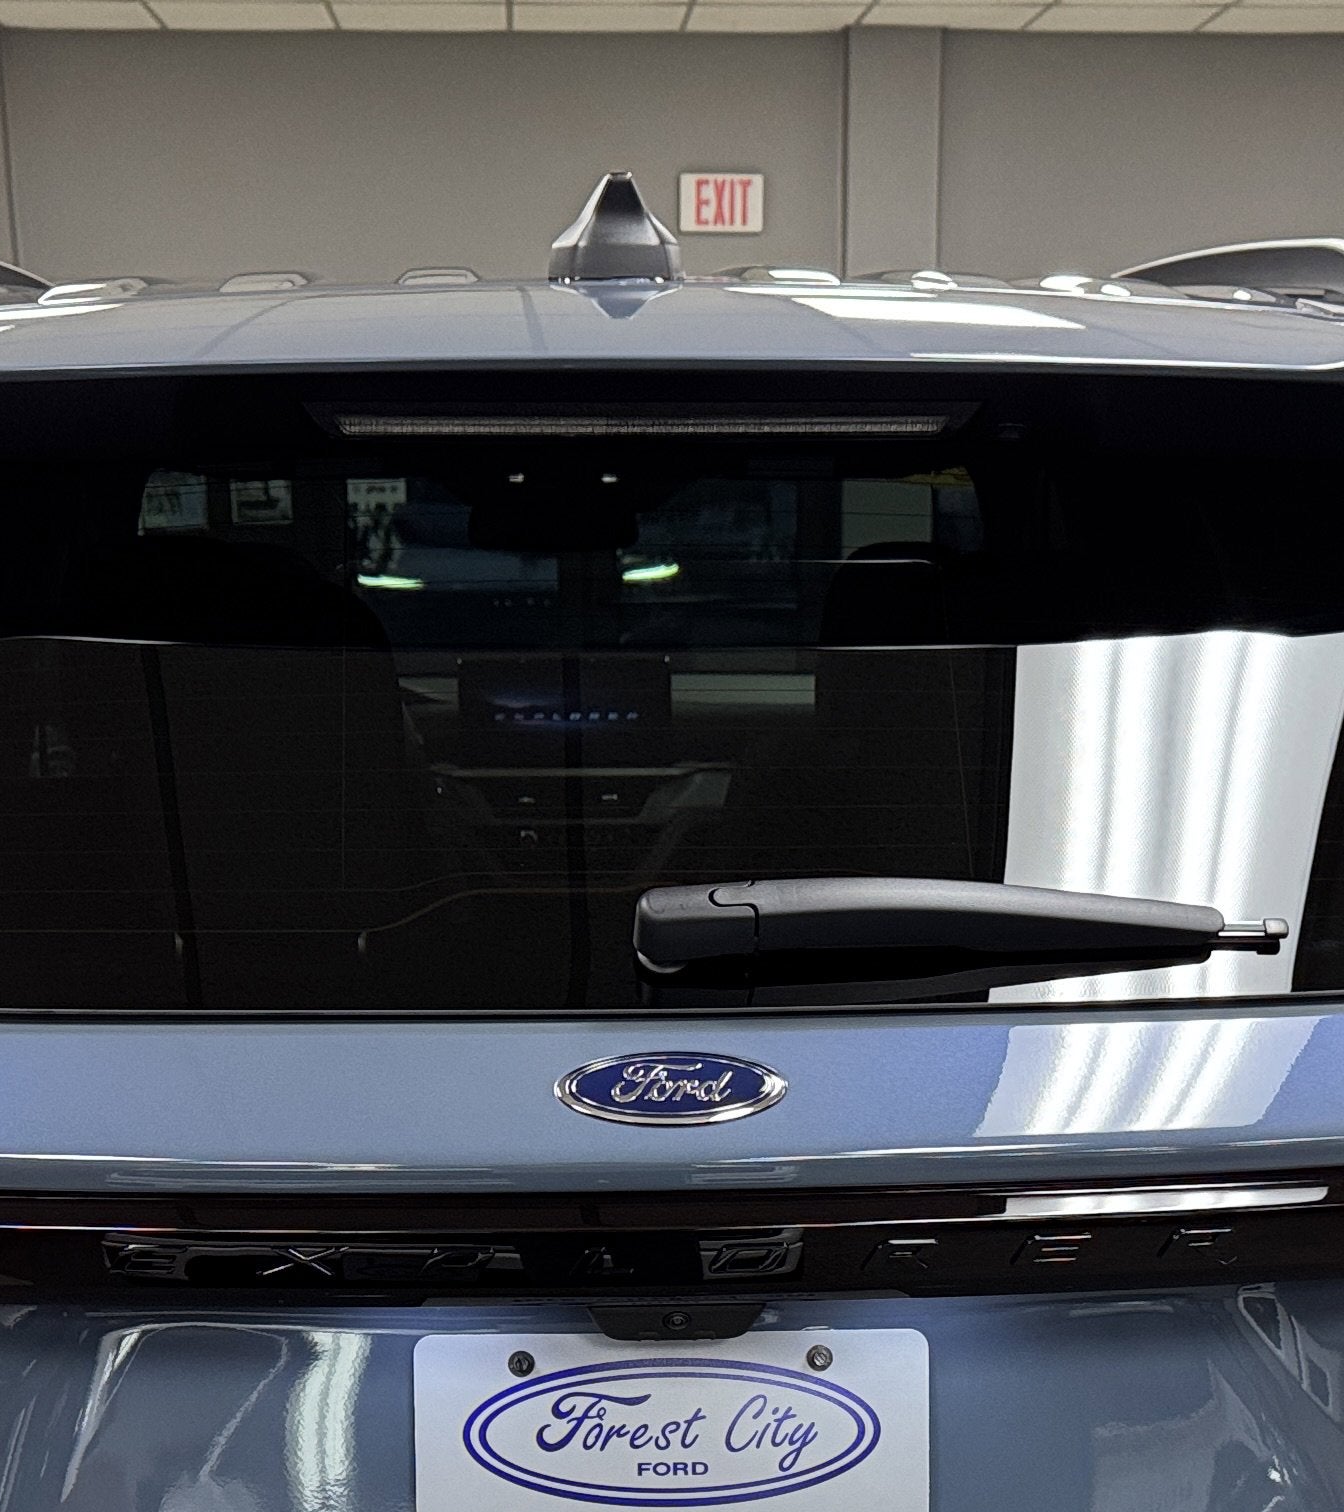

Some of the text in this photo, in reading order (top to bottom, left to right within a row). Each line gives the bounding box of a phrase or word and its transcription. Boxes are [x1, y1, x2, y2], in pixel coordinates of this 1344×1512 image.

[695, 179, 752, 226] EXIT
[610, 1062, 734, 1103] Ford
[106, 1227, 1240, 1278] EXPLORER
[536, 1391, 819, 1473] Forest City
[637, 1461, 710, 1477] FORD
